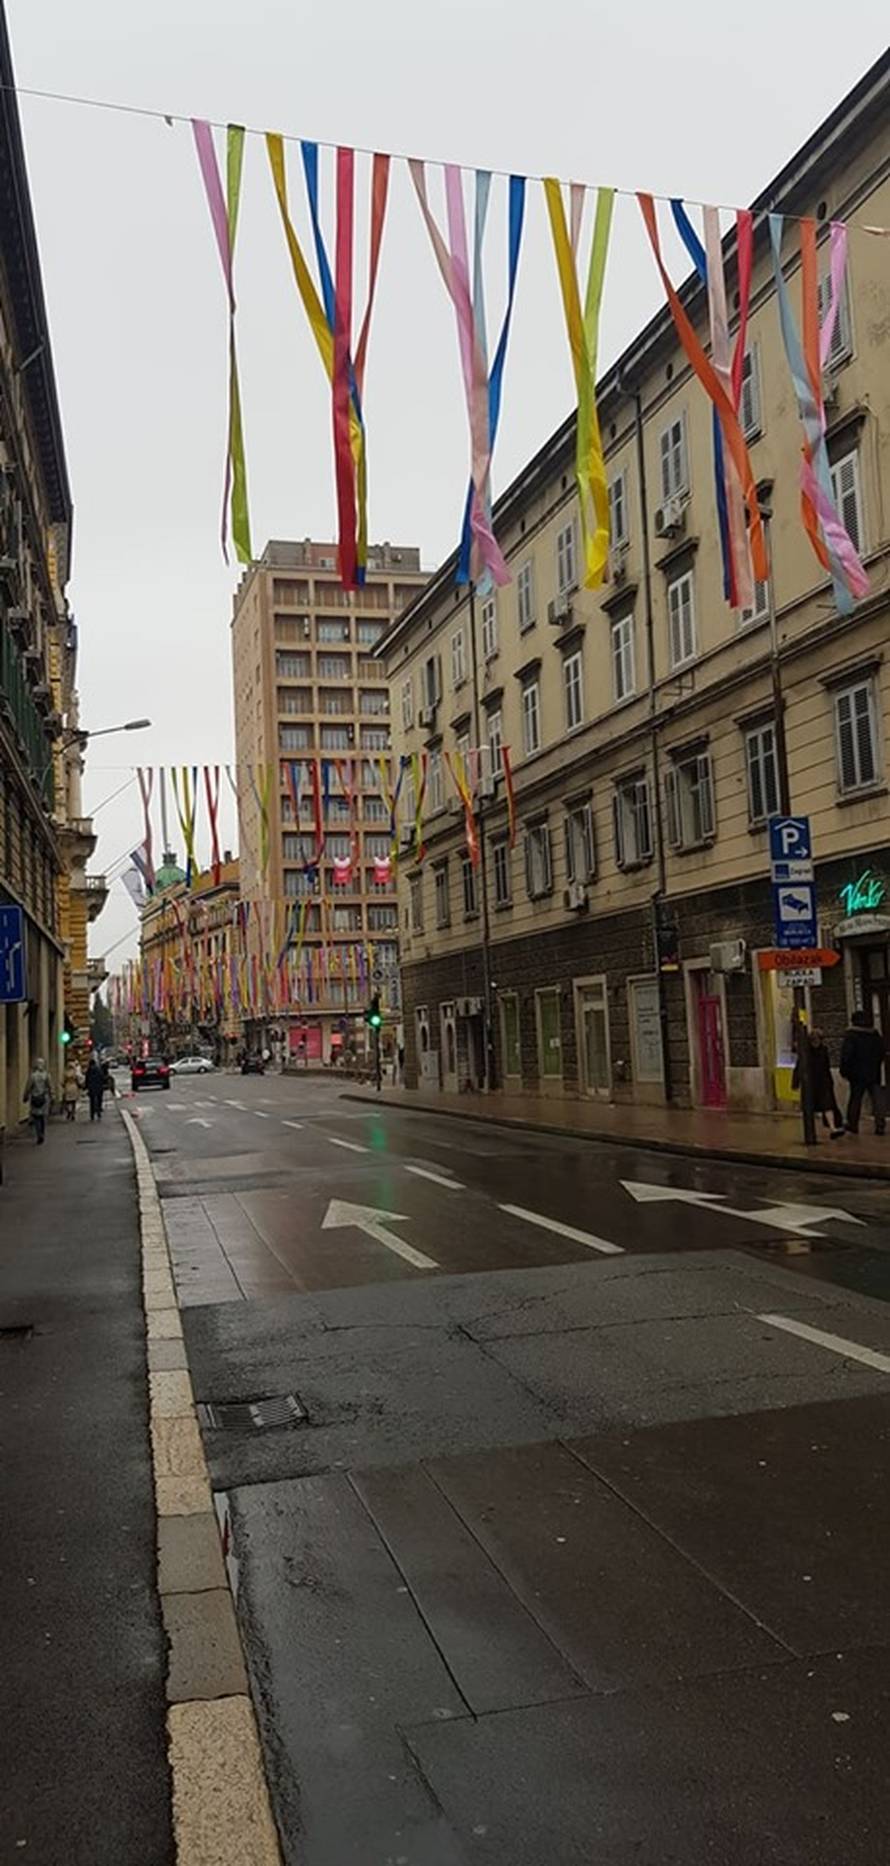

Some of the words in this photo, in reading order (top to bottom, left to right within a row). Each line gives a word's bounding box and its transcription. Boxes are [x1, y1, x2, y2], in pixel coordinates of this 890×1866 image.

[781, 828, 800, 854] P
[775, 953, 822, 966] Obilazak
[786, 978, 815, 987] ZAPAD
